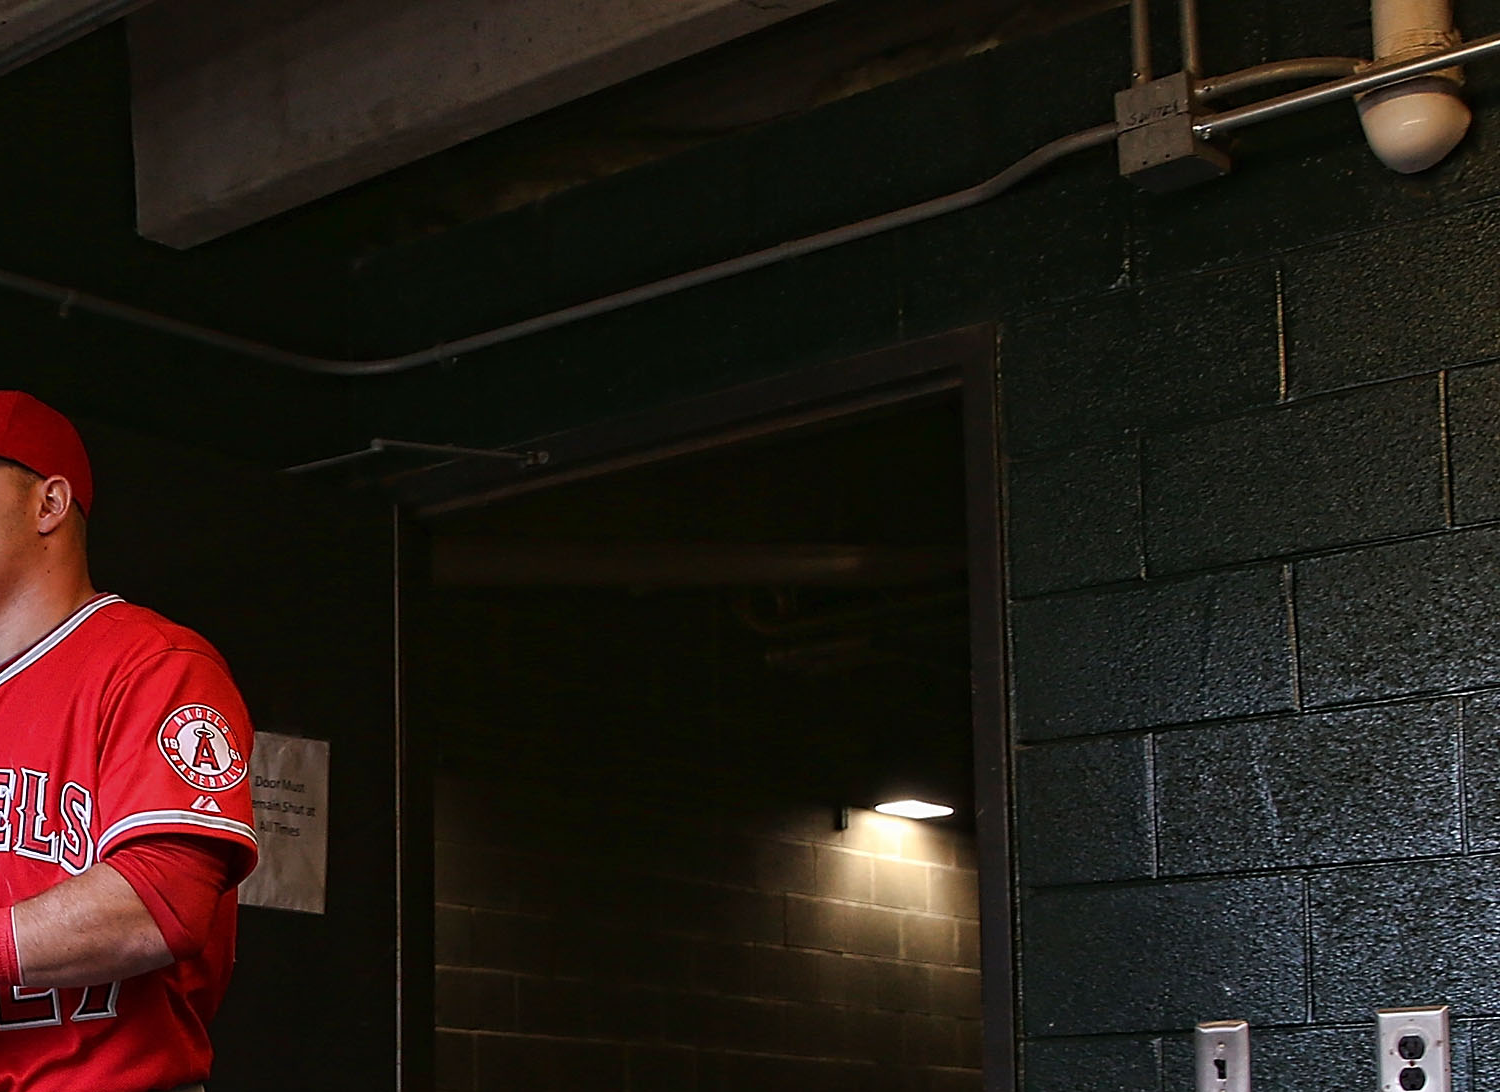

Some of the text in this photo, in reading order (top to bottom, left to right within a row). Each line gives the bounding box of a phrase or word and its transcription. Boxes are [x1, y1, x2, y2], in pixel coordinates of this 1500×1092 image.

[173, 707, 229, 734] ANGELS
[163, 738, 242, 761] 19 61
[192, 723, 221, 771] A
[170, 754, 243, 788] BASEBALL
[255, 775, 306, 793] Door Must
[252, 799, 316, 817] emain Shut at
